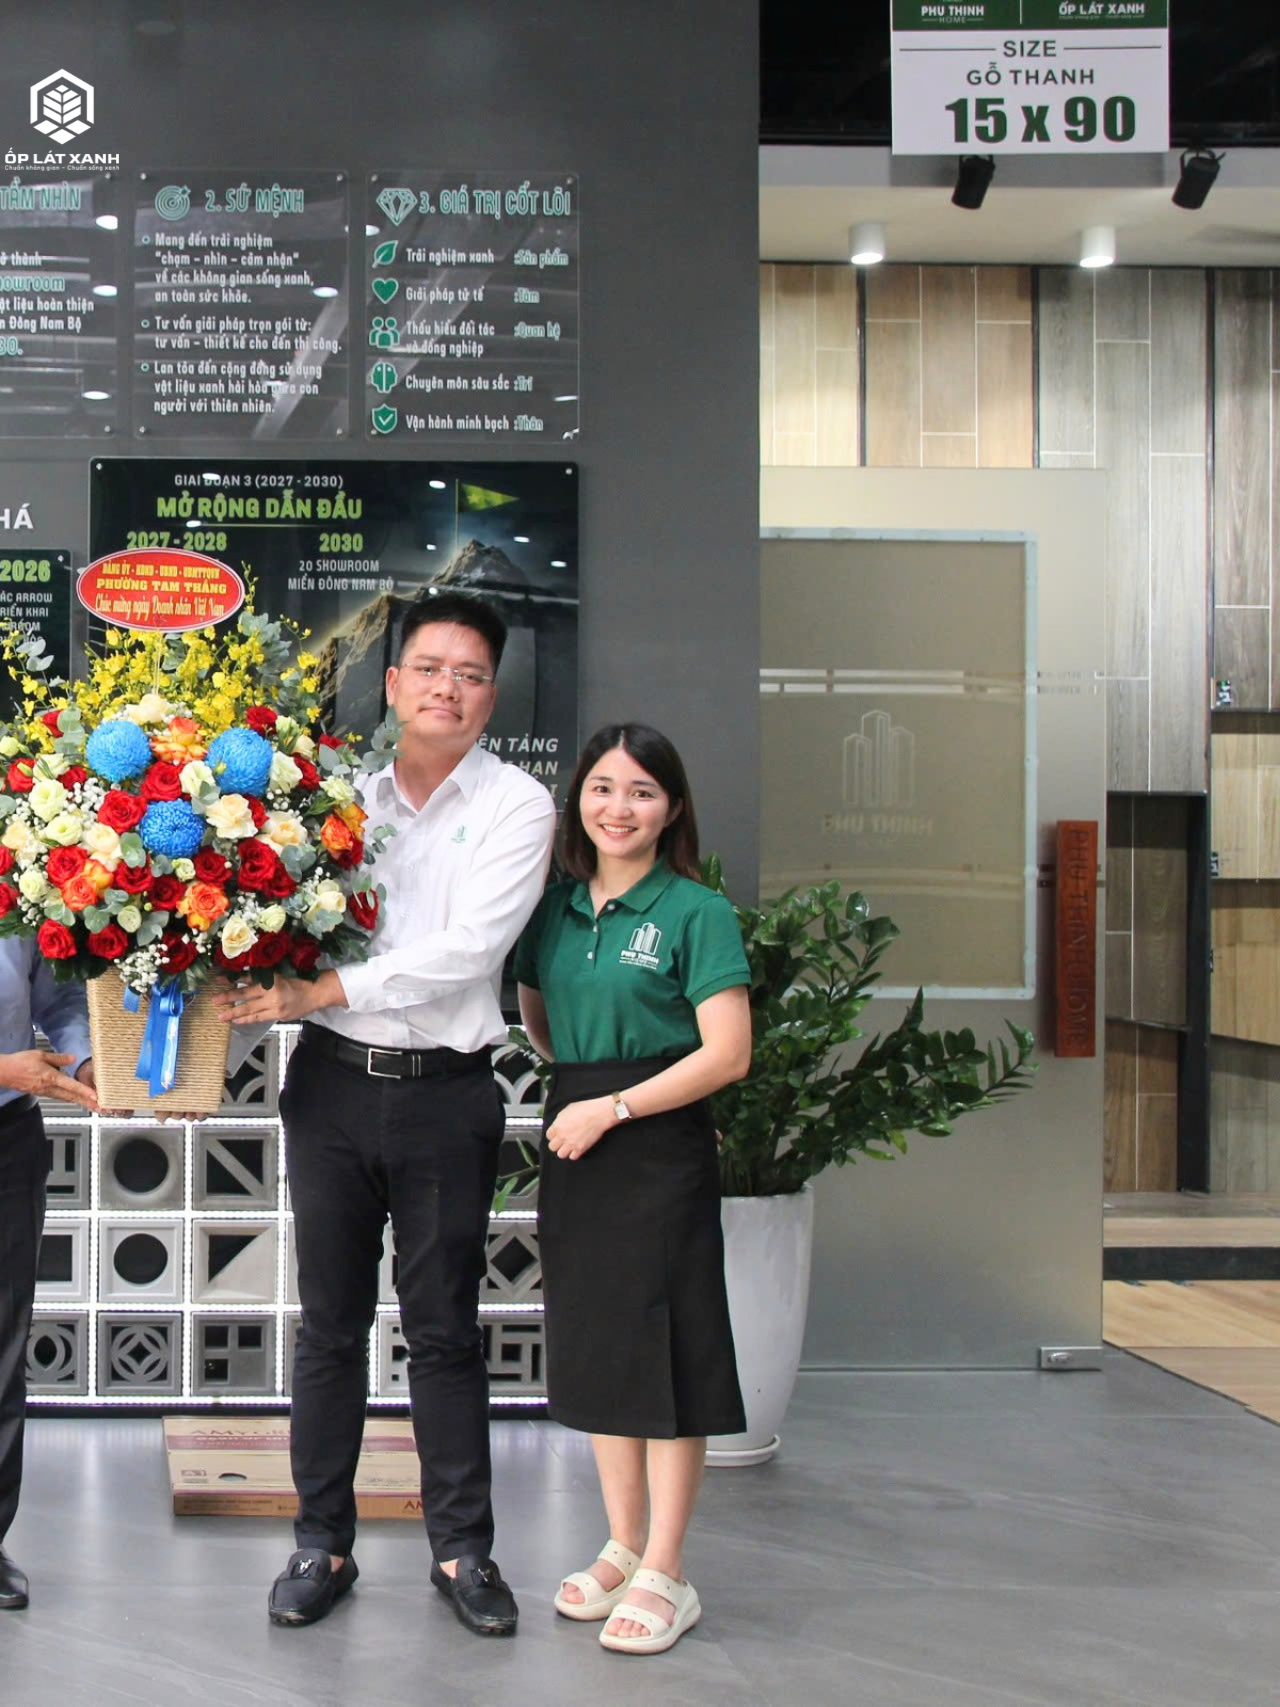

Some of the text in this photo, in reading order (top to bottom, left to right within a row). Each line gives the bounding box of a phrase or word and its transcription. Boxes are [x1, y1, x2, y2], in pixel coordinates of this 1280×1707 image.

[1059, 1, 1145, 15] ỐP LÁT XANH
[1004, 40, 1056, 58] SIZE
[967, 62, 1094, 86] GỖ THANH
[945, 98, 1007, 143] 15
[1064, 96, 1135, 142] 90
[205, 183, 304, 218] 2. SỨ MỆNH
[174, 475, 200, 486] GIAI
[244, 476, 251, 486] 3
[255, 475, 293, 488] (2027
[304, 476, 343, 488] 2030)
[157, 489, 362, 522] MỞ RỘNG DẪN ĐẦU
[127, 531, 170, 549] 2027
[183, 532, 227, 551] 2028
[320, 533, 363, 552] 2030
[0, 560, 50, 582] 2026
[299, 559, 380, 572] 20 SHOWROOM
[14, 593, 52, 604] ARROW
[26, 608, 48, 616] KHAI
